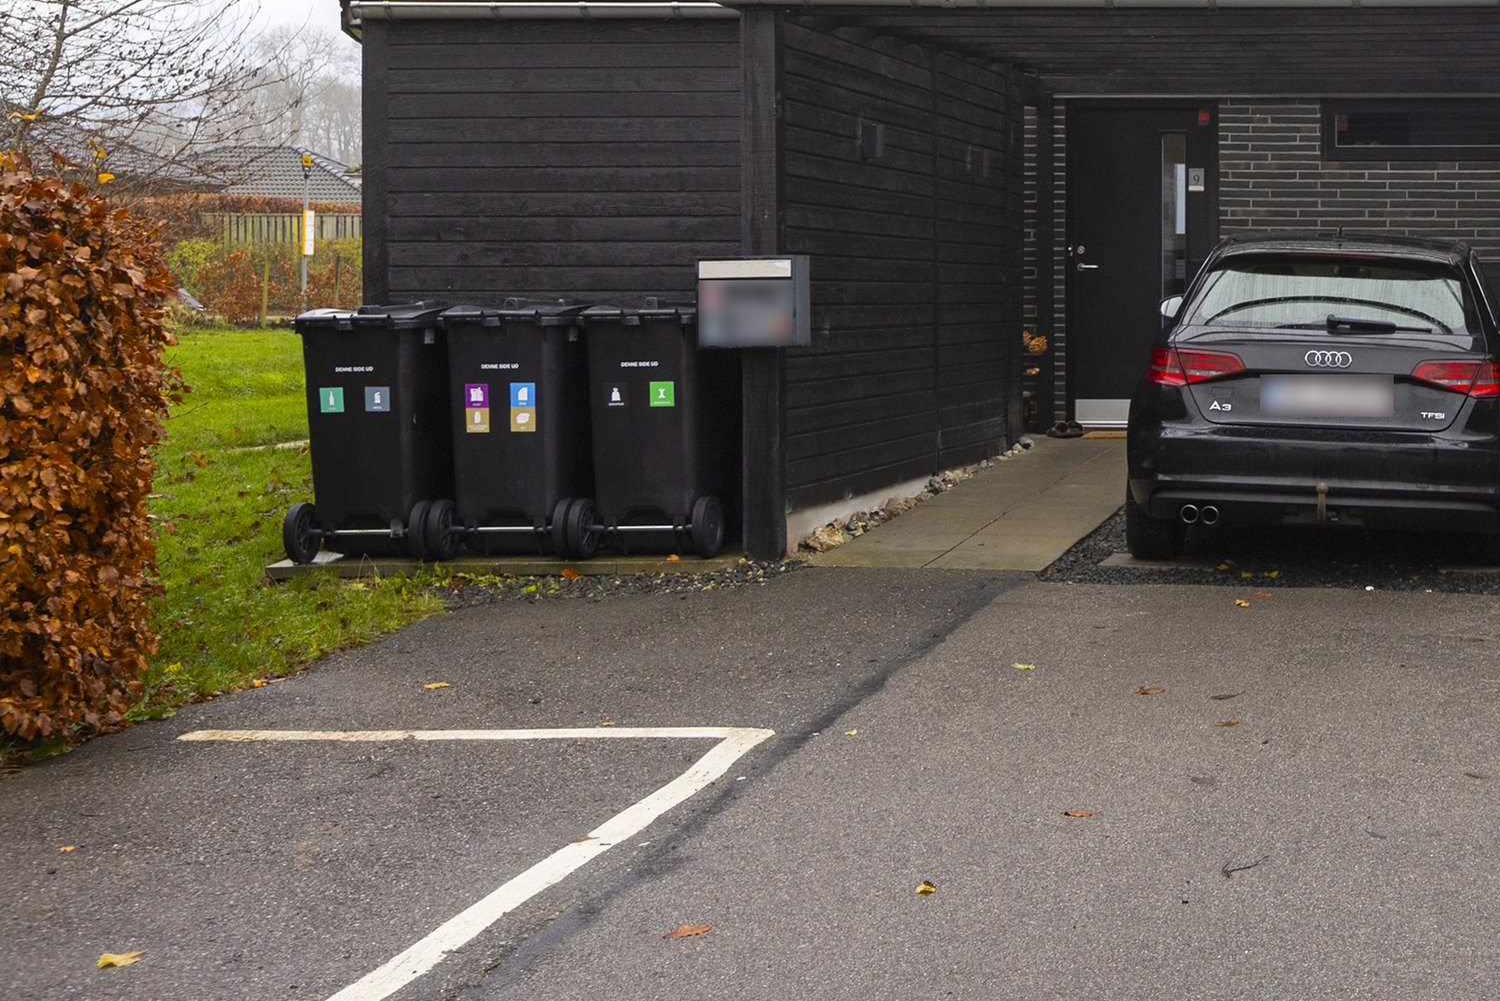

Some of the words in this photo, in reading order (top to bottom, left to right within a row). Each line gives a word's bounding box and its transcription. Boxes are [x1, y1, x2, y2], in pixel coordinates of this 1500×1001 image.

[1192, 174, 1200, 185] 9
[1209, 400, 1232, 411] A3
[1420, 411, 1445, 420] TFSI
